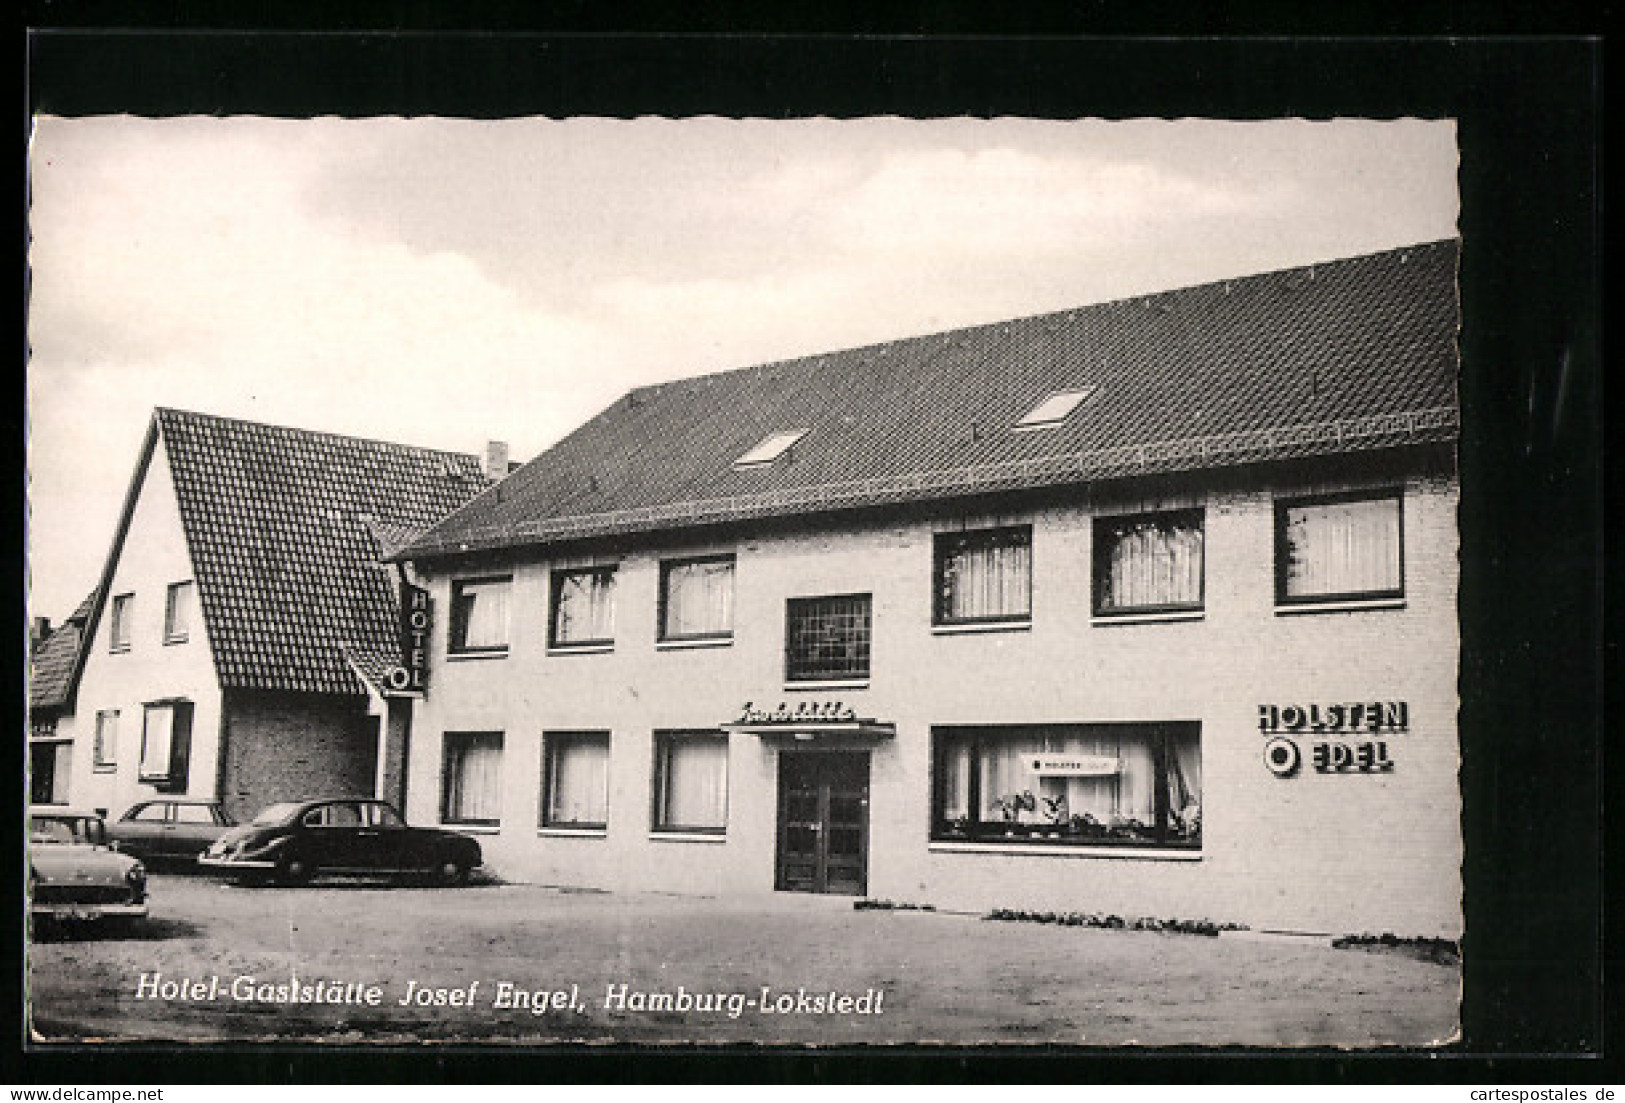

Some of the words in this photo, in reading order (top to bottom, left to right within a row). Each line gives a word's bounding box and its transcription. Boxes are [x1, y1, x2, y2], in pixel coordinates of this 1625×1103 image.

[411, 592, 427, 687] HOTEL
[1257, 701, 1410, 733] HOLSTEN
[1311, 742, 1395, 774] EDEL
